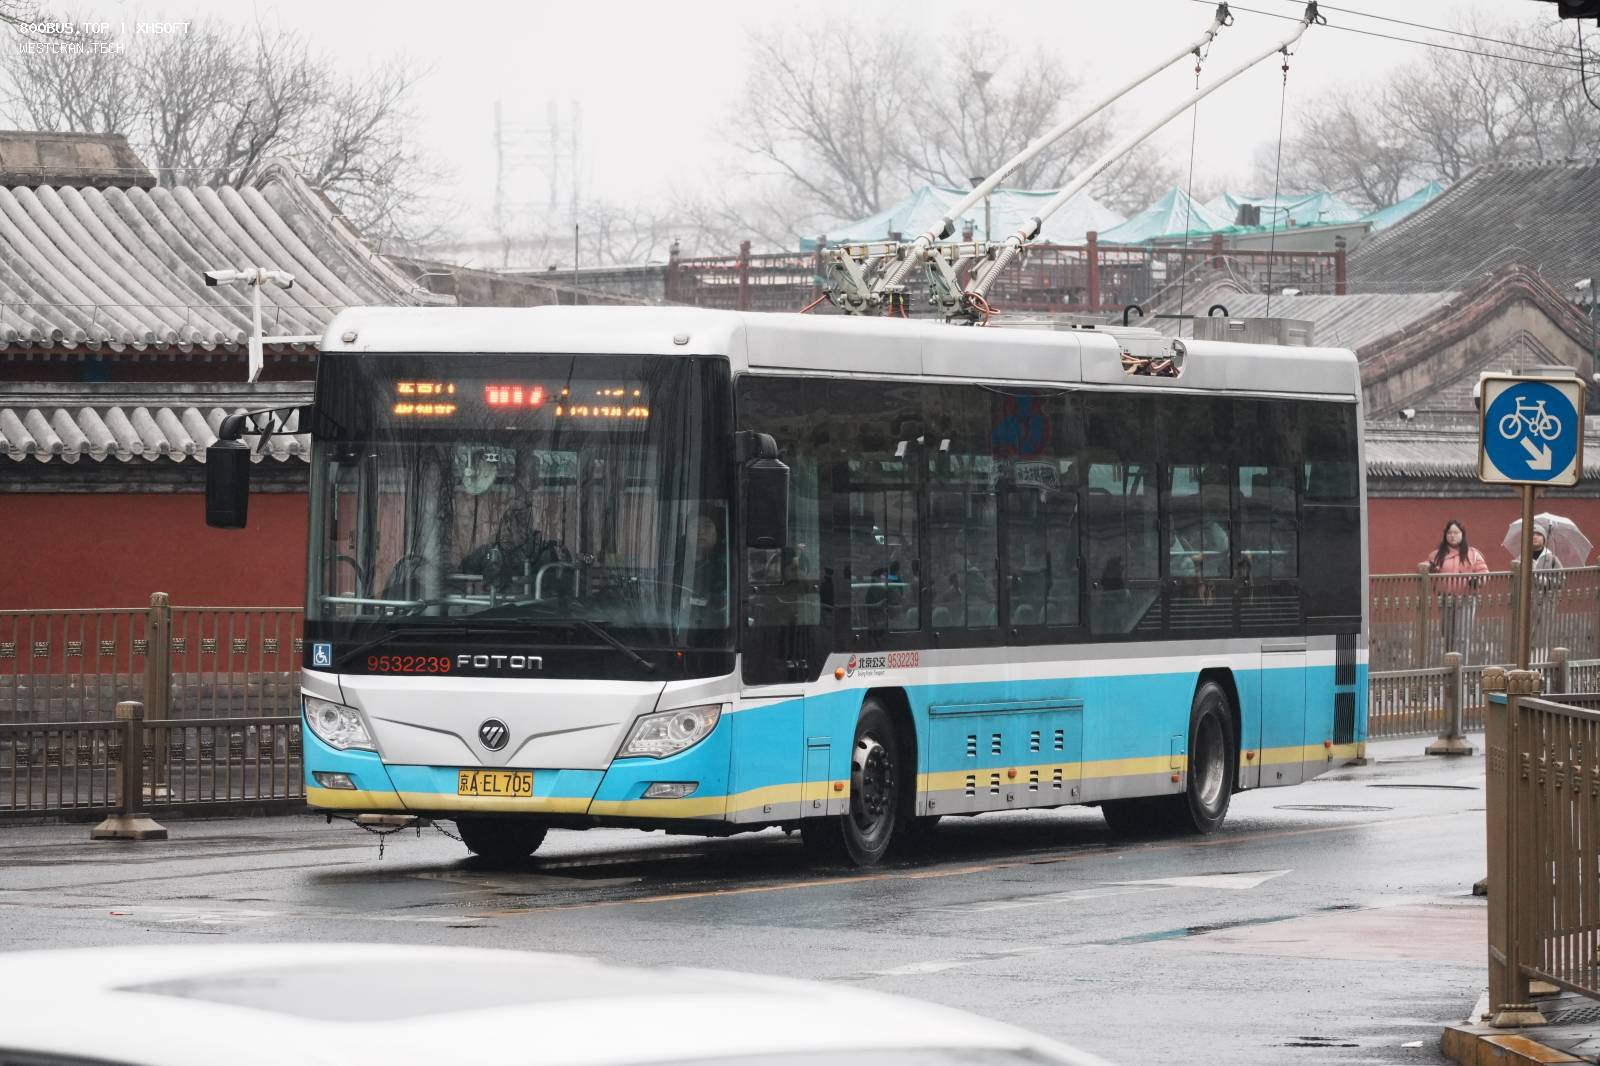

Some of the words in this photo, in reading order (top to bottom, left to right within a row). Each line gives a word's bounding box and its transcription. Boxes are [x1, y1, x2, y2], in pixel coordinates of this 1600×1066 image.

[367, 655, 451, 673] 9532239
[457, 654, 543, 670] FOTON
[858, 656, 886, 669] 北京公交
[887, 651, 919, 669] 9532239
